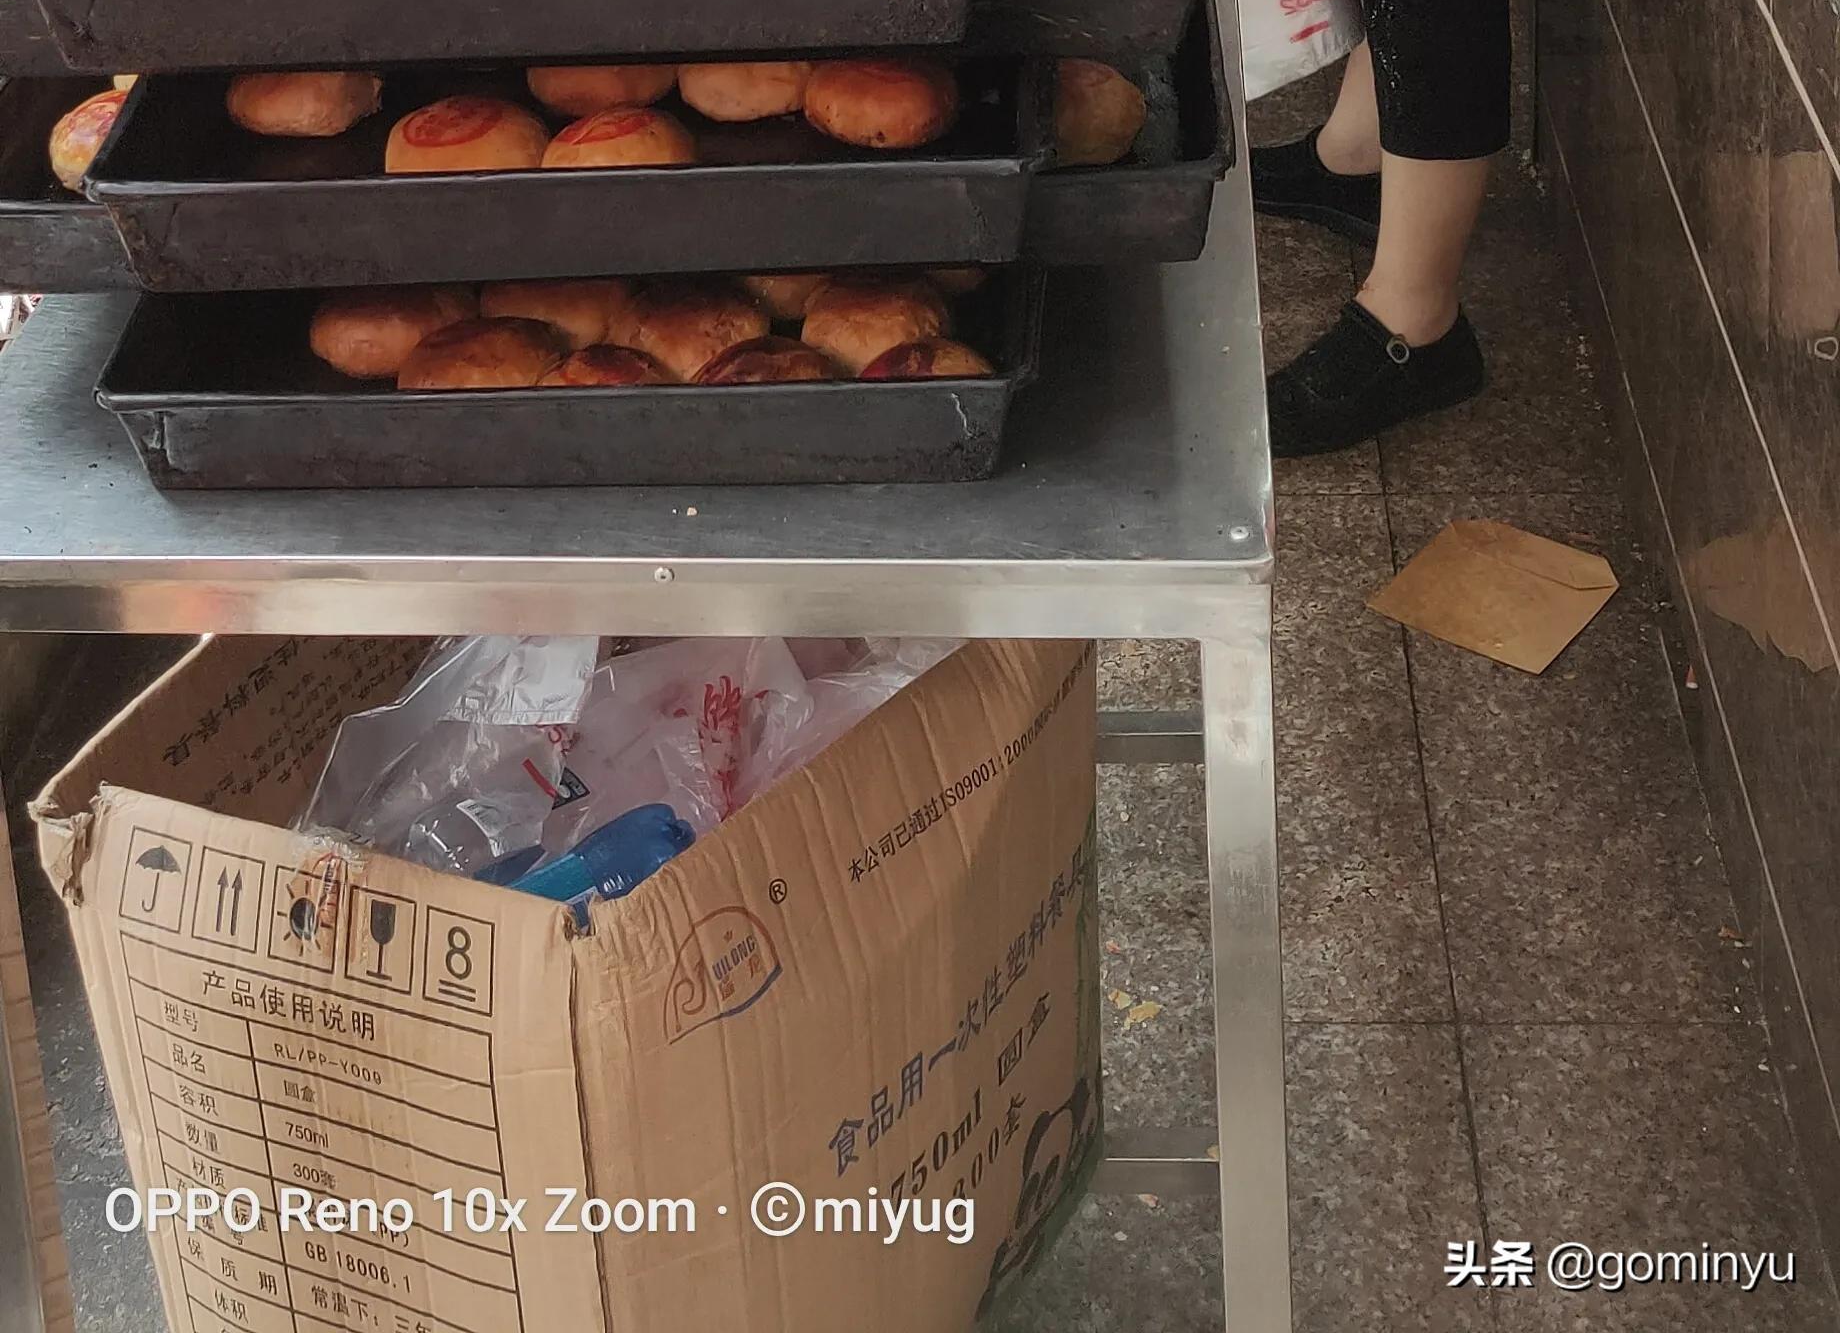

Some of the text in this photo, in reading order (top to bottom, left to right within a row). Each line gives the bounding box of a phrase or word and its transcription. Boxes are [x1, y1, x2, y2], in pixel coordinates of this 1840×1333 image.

[164, 1001, 199, 1033] 型号
[203, 971, 375, 1041] 产品使用说明
[172, 1043, 207, 1074] 品名
[179, 1084, 329, 1149] 容积 750ml
[192, 1156, 226, 1190] 材质
[305, 1241, 412, 1295] GB 18006.1
